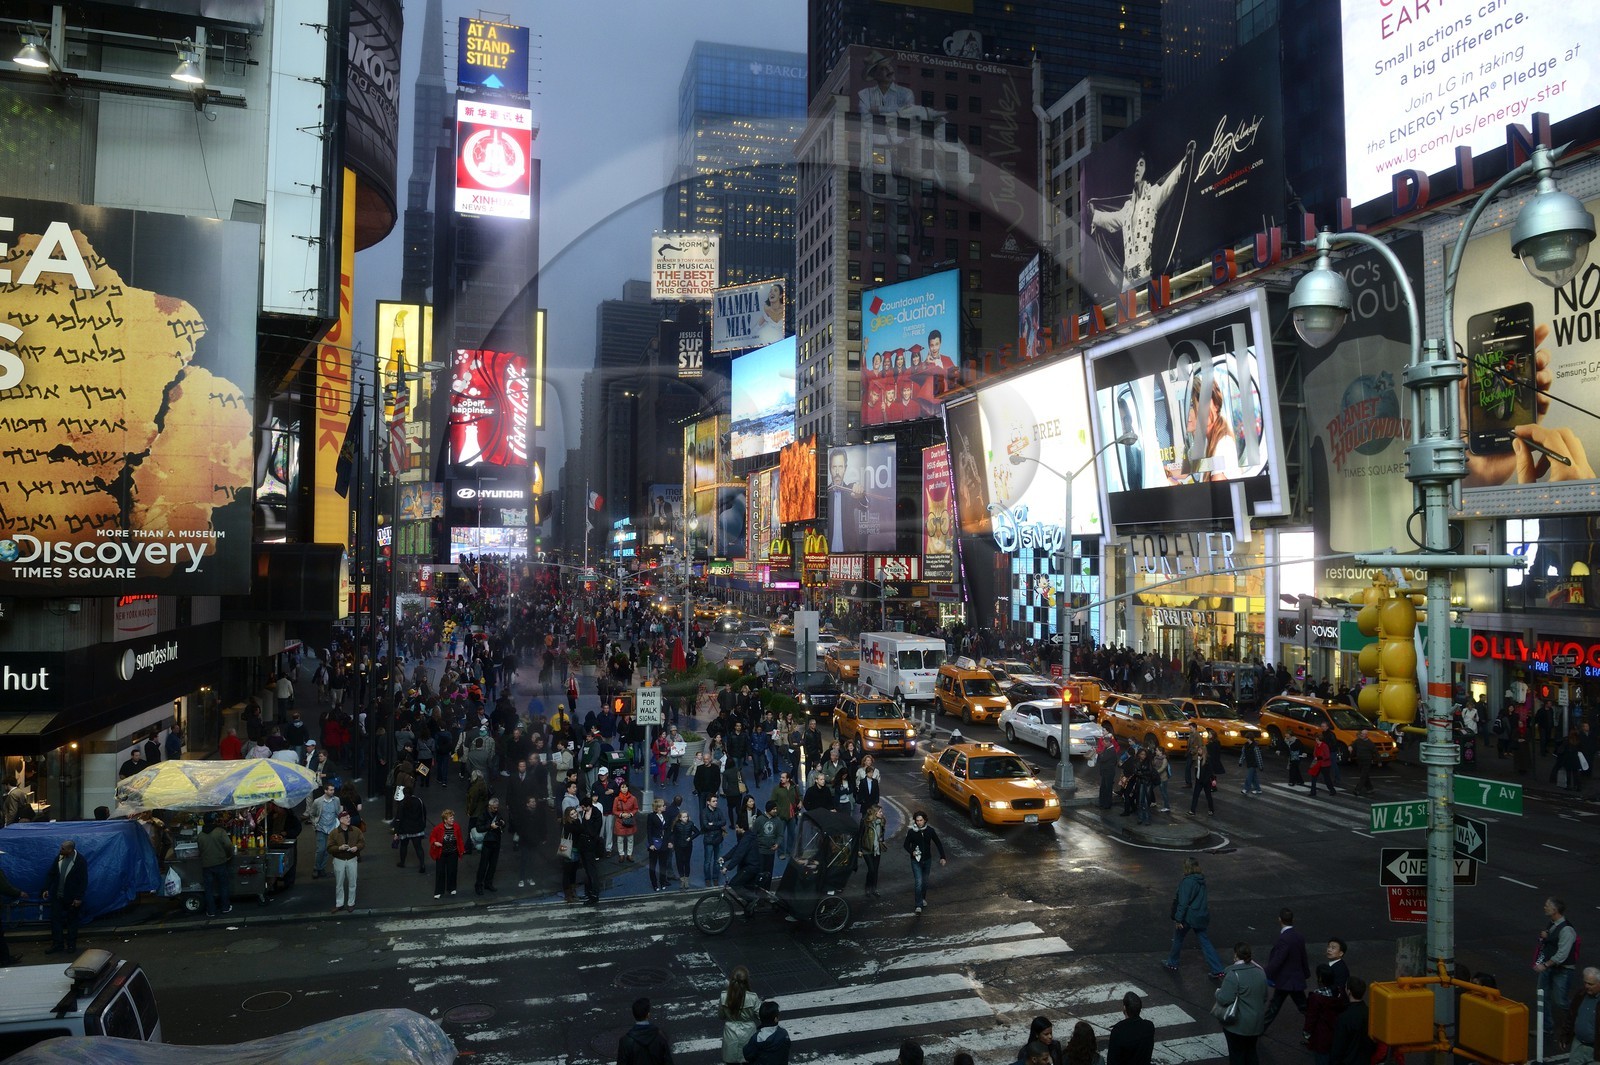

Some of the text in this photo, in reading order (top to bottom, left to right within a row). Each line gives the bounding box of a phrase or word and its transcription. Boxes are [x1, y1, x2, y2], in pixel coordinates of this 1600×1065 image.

[1381, 0, 1443, 39] EAR
[467, 23, 484, 36] AT
[488, 26, 497, 39] A
[467, 37, 515, 55] STAND-
[1375, 43, 1412, 75] Small
[1418, 14, 1472, 52] actions
[1400, 10, 1529, 86] a big difference.
[467, 51, 508, 69] STILL?
[897, 52, 1008, 75] 100% Colombian Coffee
[765, 64, 808, 79] BARCL
[1405, 44, 1525, 113] Join LG in taking
[1367, 138, 1385, 155] the
[1389, 106, 1445, 143] ENERGY
[1503, 55, 1557, 90] Pledge
[1564, 42, 1581, 62] at
[1376, 79, 1567, 173] www.lg.com/us/energy-star
[656, 280, 715, 288] MUSICAL OF
[683, 270, 715, 280] BEST
[717, 291, 760, 318] MAMMA
[880, 292, 935, 312] Countdown to
[679, 331, 696, 339] JESUS
[726, 314, 751, 339] MIA!
[1556, 367, 1587, 379] Samsung
[1032, 418, 1062, 442] FREE
[1327, 397, 1382, 453] PLANET
[1344, 463, 1405, 478] TIMES SQUARE
[478, 489, 523, 499] HYUNDAI
[97, 529, 226, 539] MORE THAN A MUSEUM
[12, 534, 208, 573] Discovery
[1131, 532, 1238, 576] FOREVER
[12, 567, 136, 579] TIMES SQUARE
[1325, 565, 1382, 580] restaura
[116, 611, 126, 621] NEW
[126, 609, 138, 620] YORK
[1152, 607, 1195, 628] FOREVER
[1295, 623, 1339, 638] SROVSK
[136, 641, 178, 672] sunglass hut
[861, 638, 885, 666] FedEx
[3, 665, 50, 691] hut
[1479, 783, 1516, 805] 7 Av
[1372, 808, 1387, 829] W
[1393, 805, 1413, 827] 45
[1457, 827, 1476, 846] WAY
[1399, 860, 1427, 875] ONE
[1391, 888, 1402, 896] NO
